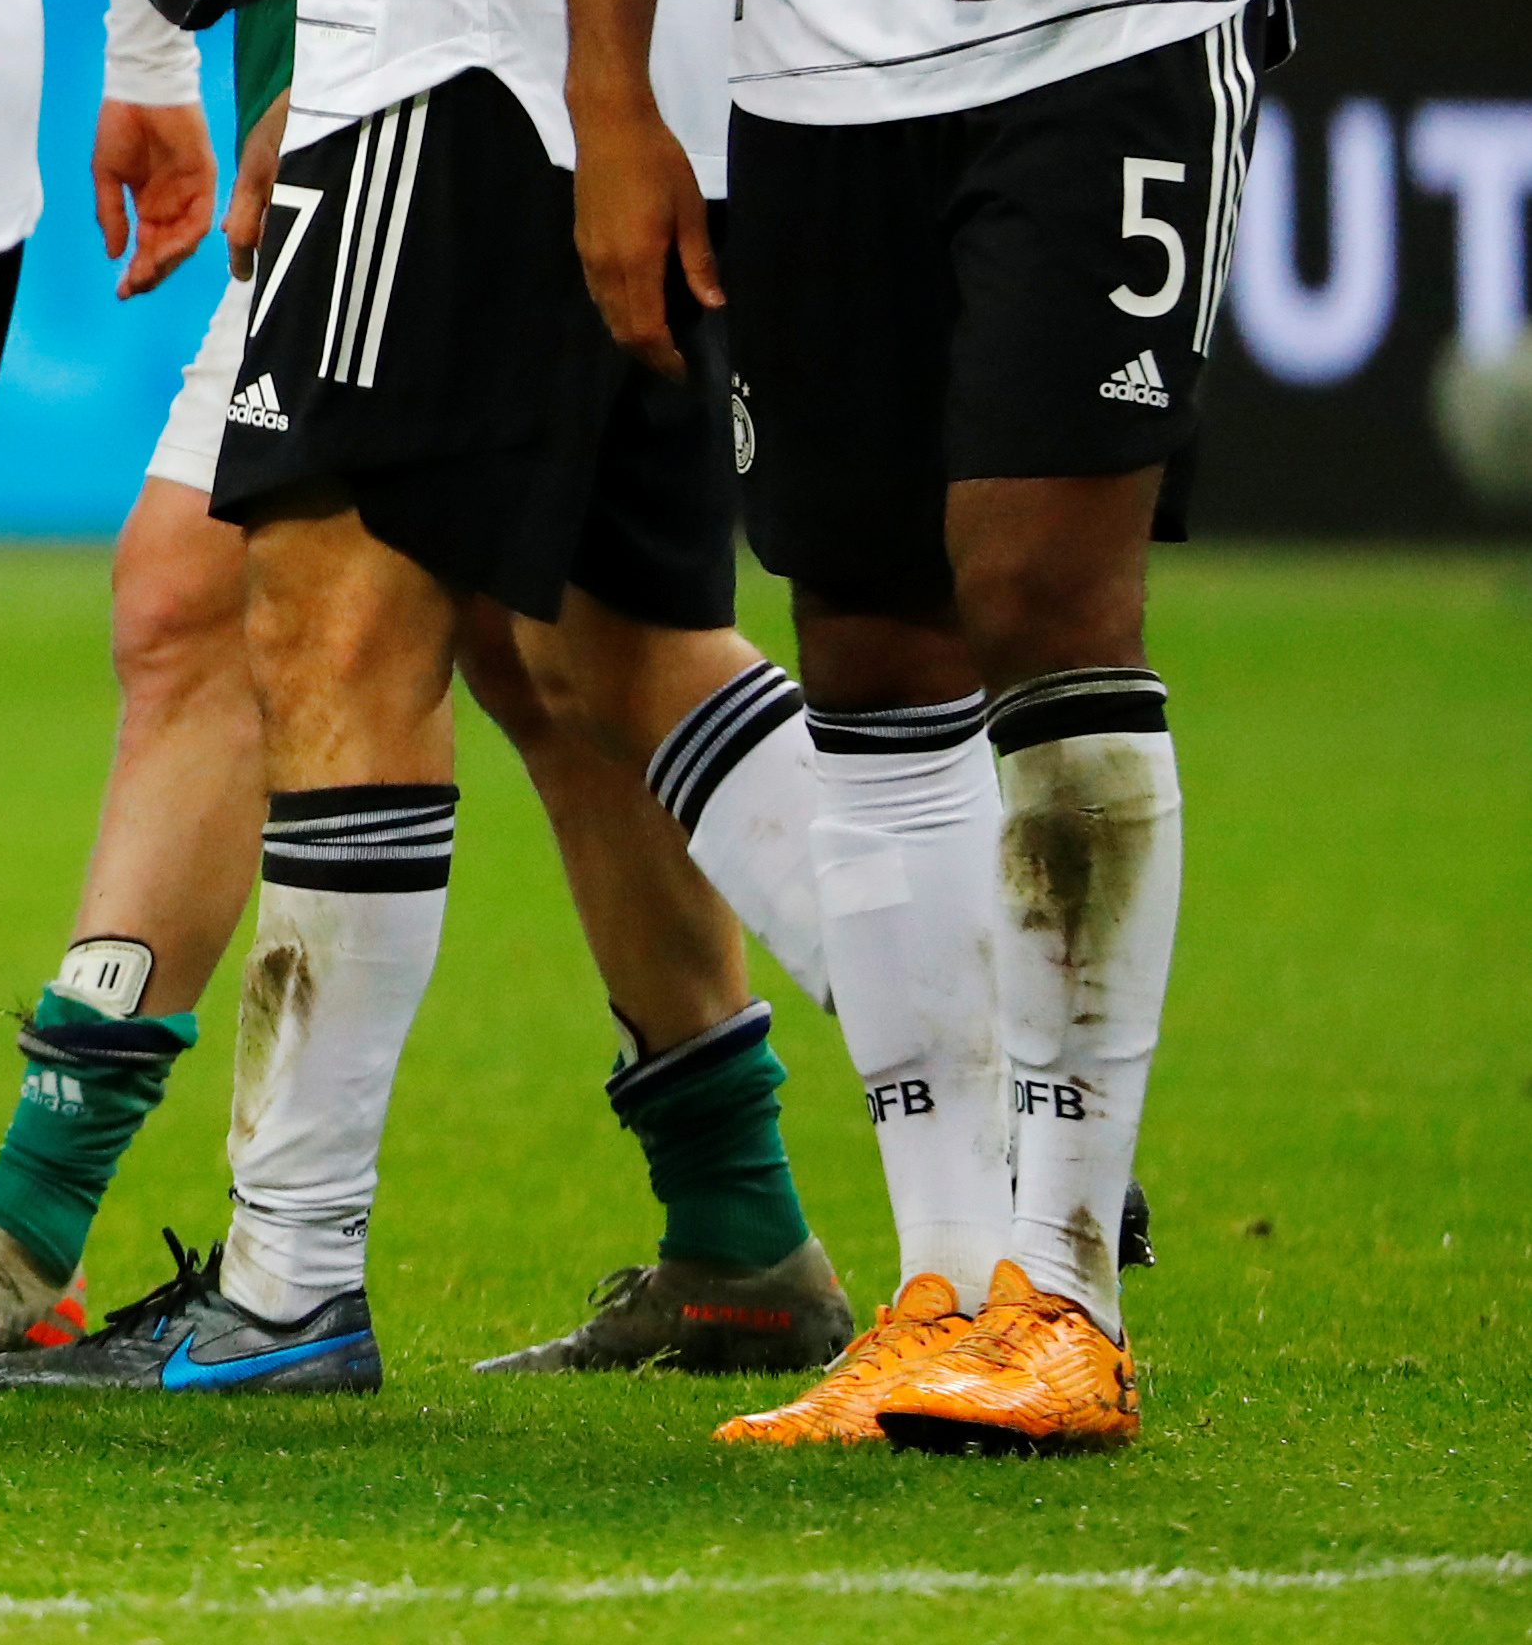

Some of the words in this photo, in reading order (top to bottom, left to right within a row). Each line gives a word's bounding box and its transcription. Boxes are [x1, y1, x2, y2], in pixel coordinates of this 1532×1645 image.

[1108, 157, 1186, 318] 5
[250, 183, 324, 338] 7
[1099, 382, 1169, 409] adidas
[227, 404, 289, 432] adidas
[1015, 1080, 1086, 1121] DFB
